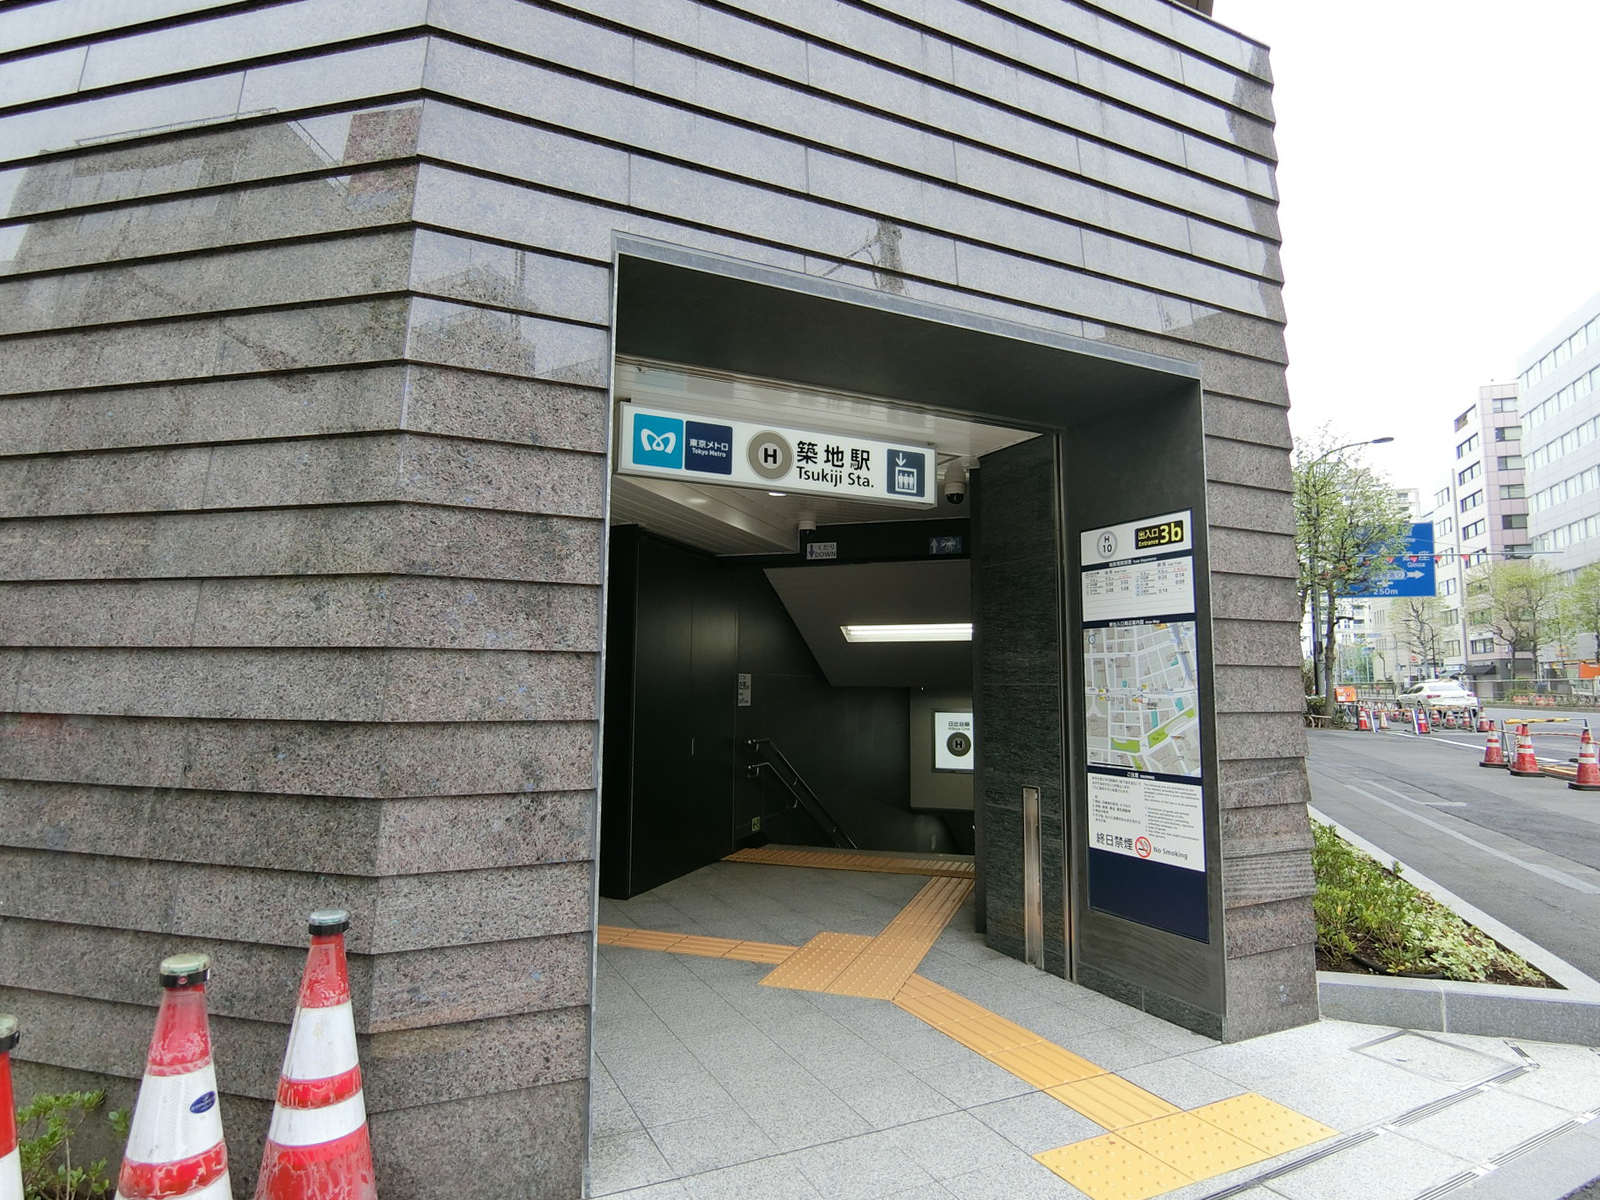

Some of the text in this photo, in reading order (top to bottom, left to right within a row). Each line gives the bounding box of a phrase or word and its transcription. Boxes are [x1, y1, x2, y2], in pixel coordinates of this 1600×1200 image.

[689, 438, 728, 451] 東京メトロ
[691, 448, 726, 458] Tokyo Metro
[763, 447, 777, 464] H
[797, 441, 870, 471] 築地駅
[796, 466, 874, 488] Tsukiji Sta.
[1138, 529, 1159, 540] 出入口
[1160, 522, 1182, 543] 3b
[1104, 535, 1110, 543] H
[1138, 539, 1159, 547] Entrance
[817, 543, 835, 551] くだり
[1102, 544, 1112, 553] 10
[955, 740, 963, 748] H
[1096, 832, 1133, 851] 終日禁煙
[1153, 846, 1188, 860] No Smoking
